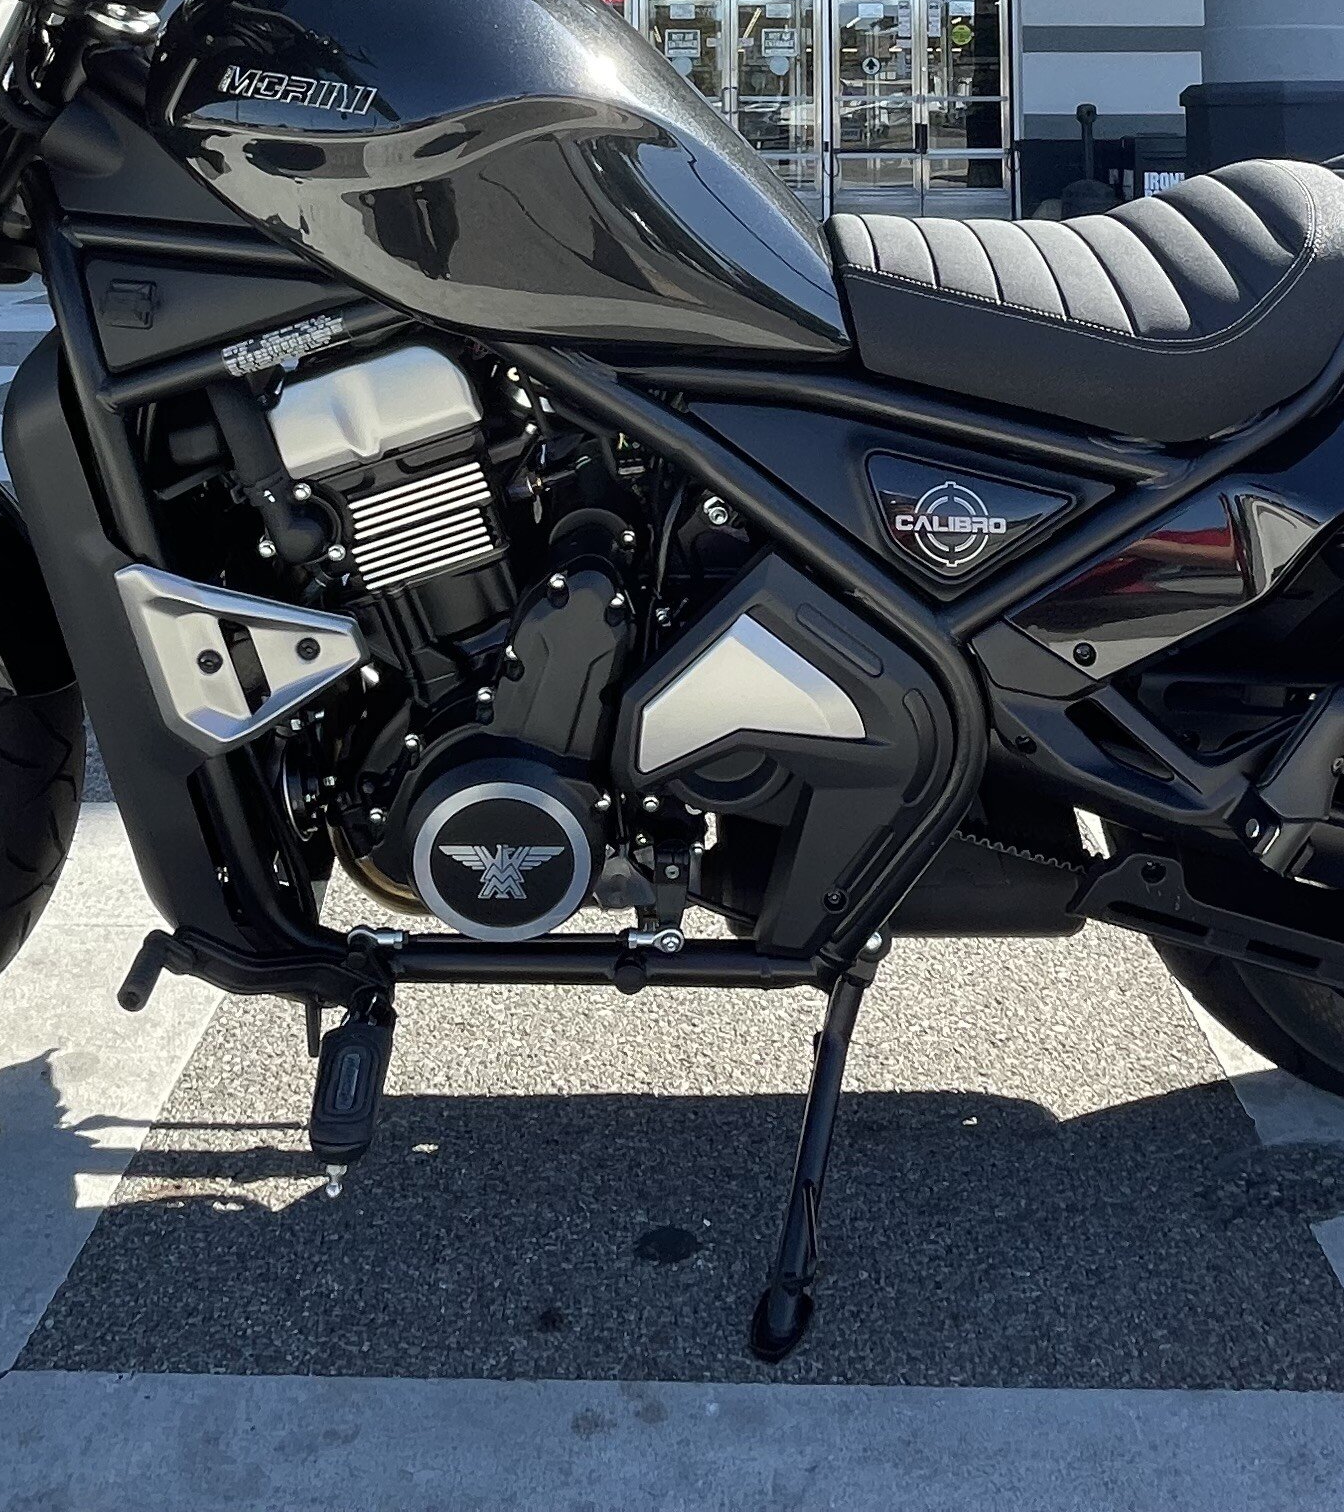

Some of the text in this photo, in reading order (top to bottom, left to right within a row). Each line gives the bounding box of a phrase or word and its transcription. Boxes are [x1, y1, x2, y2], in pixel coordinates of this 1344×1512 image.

[218, 65, 378, 116] MORINI
[1144, 172, 1180, 190] IRON
[895, 514, 1007, 535] CALIBRO
